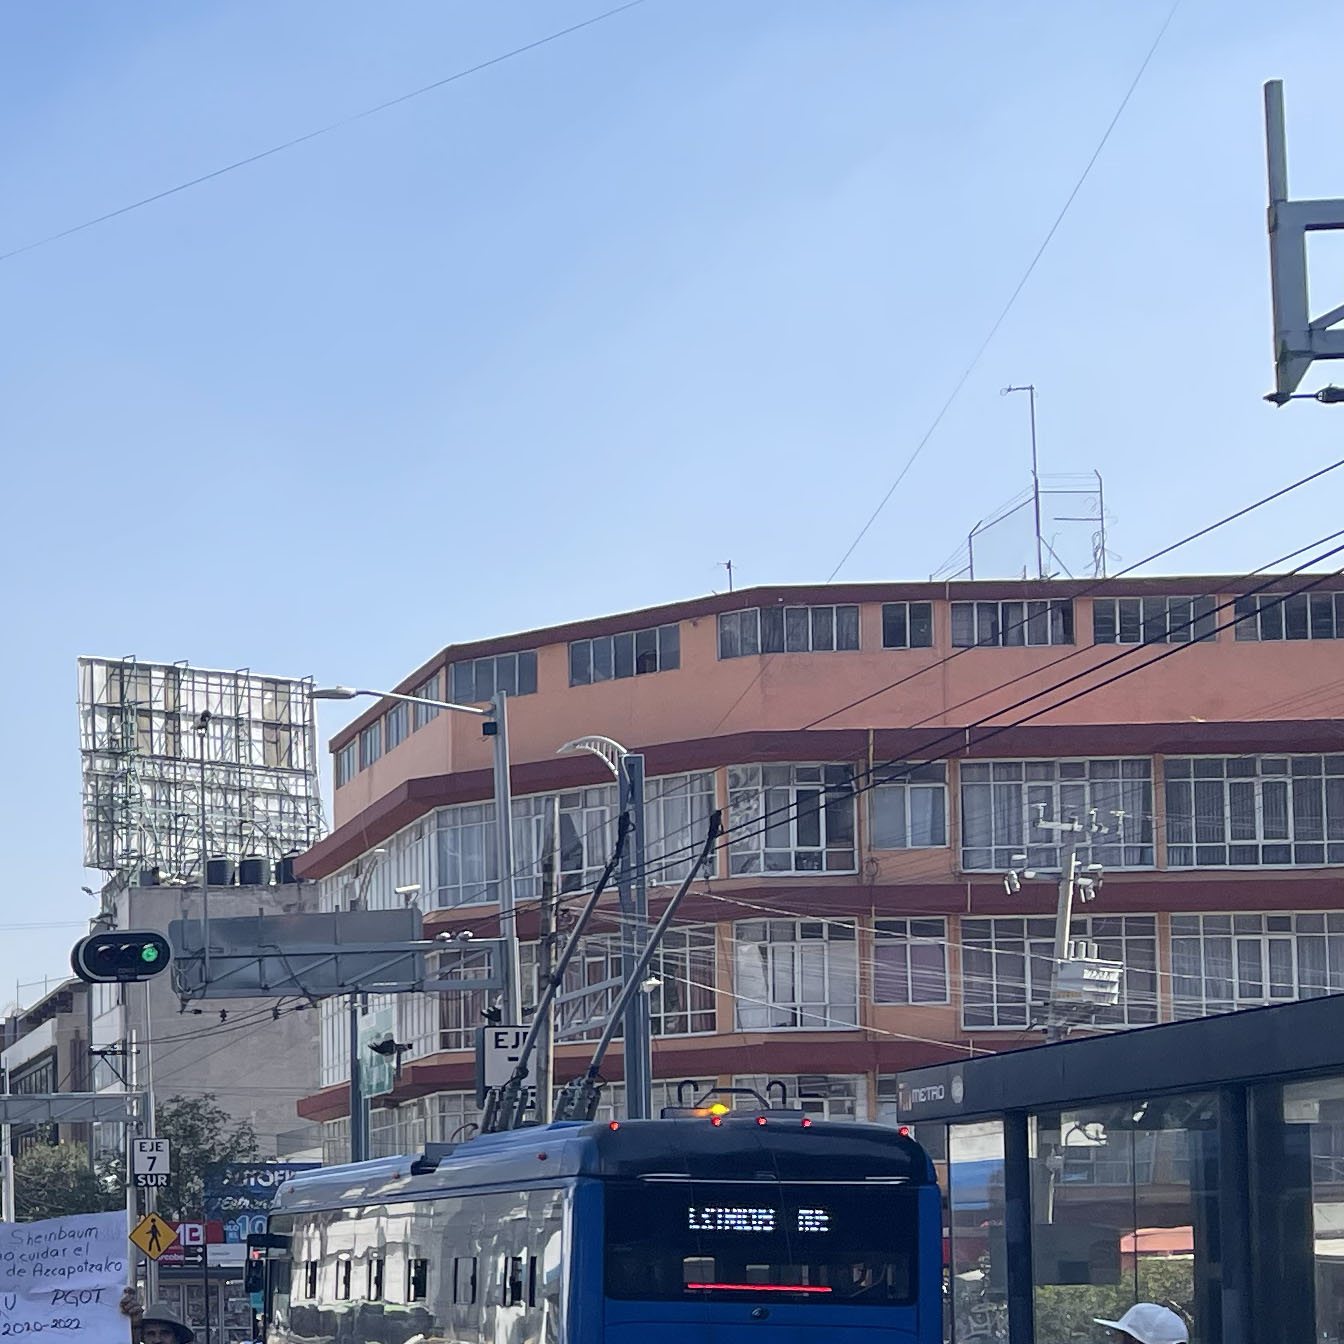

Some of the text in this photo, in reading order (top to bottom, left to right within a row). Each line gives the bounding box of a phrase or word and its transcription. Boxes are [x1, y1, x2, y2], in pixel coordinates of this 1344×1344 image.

[912, 1085, 944, 1102] METRO
[140, 1141, 164, 1152] EJE
[147, 1156, 156, 1171] 7
[137, 1174, 167, 1186] SUR
[11, 1226, 98, 1247] Sheinbaum
[21, 1245, 68, 1263] cuidar
[75, 1242, 89, 1257] el
[6, 1263, 26, 1278] de
[51, 1287, 106, 1307] PGOT
[1, 1318, 83, 1336] 2020-2022
